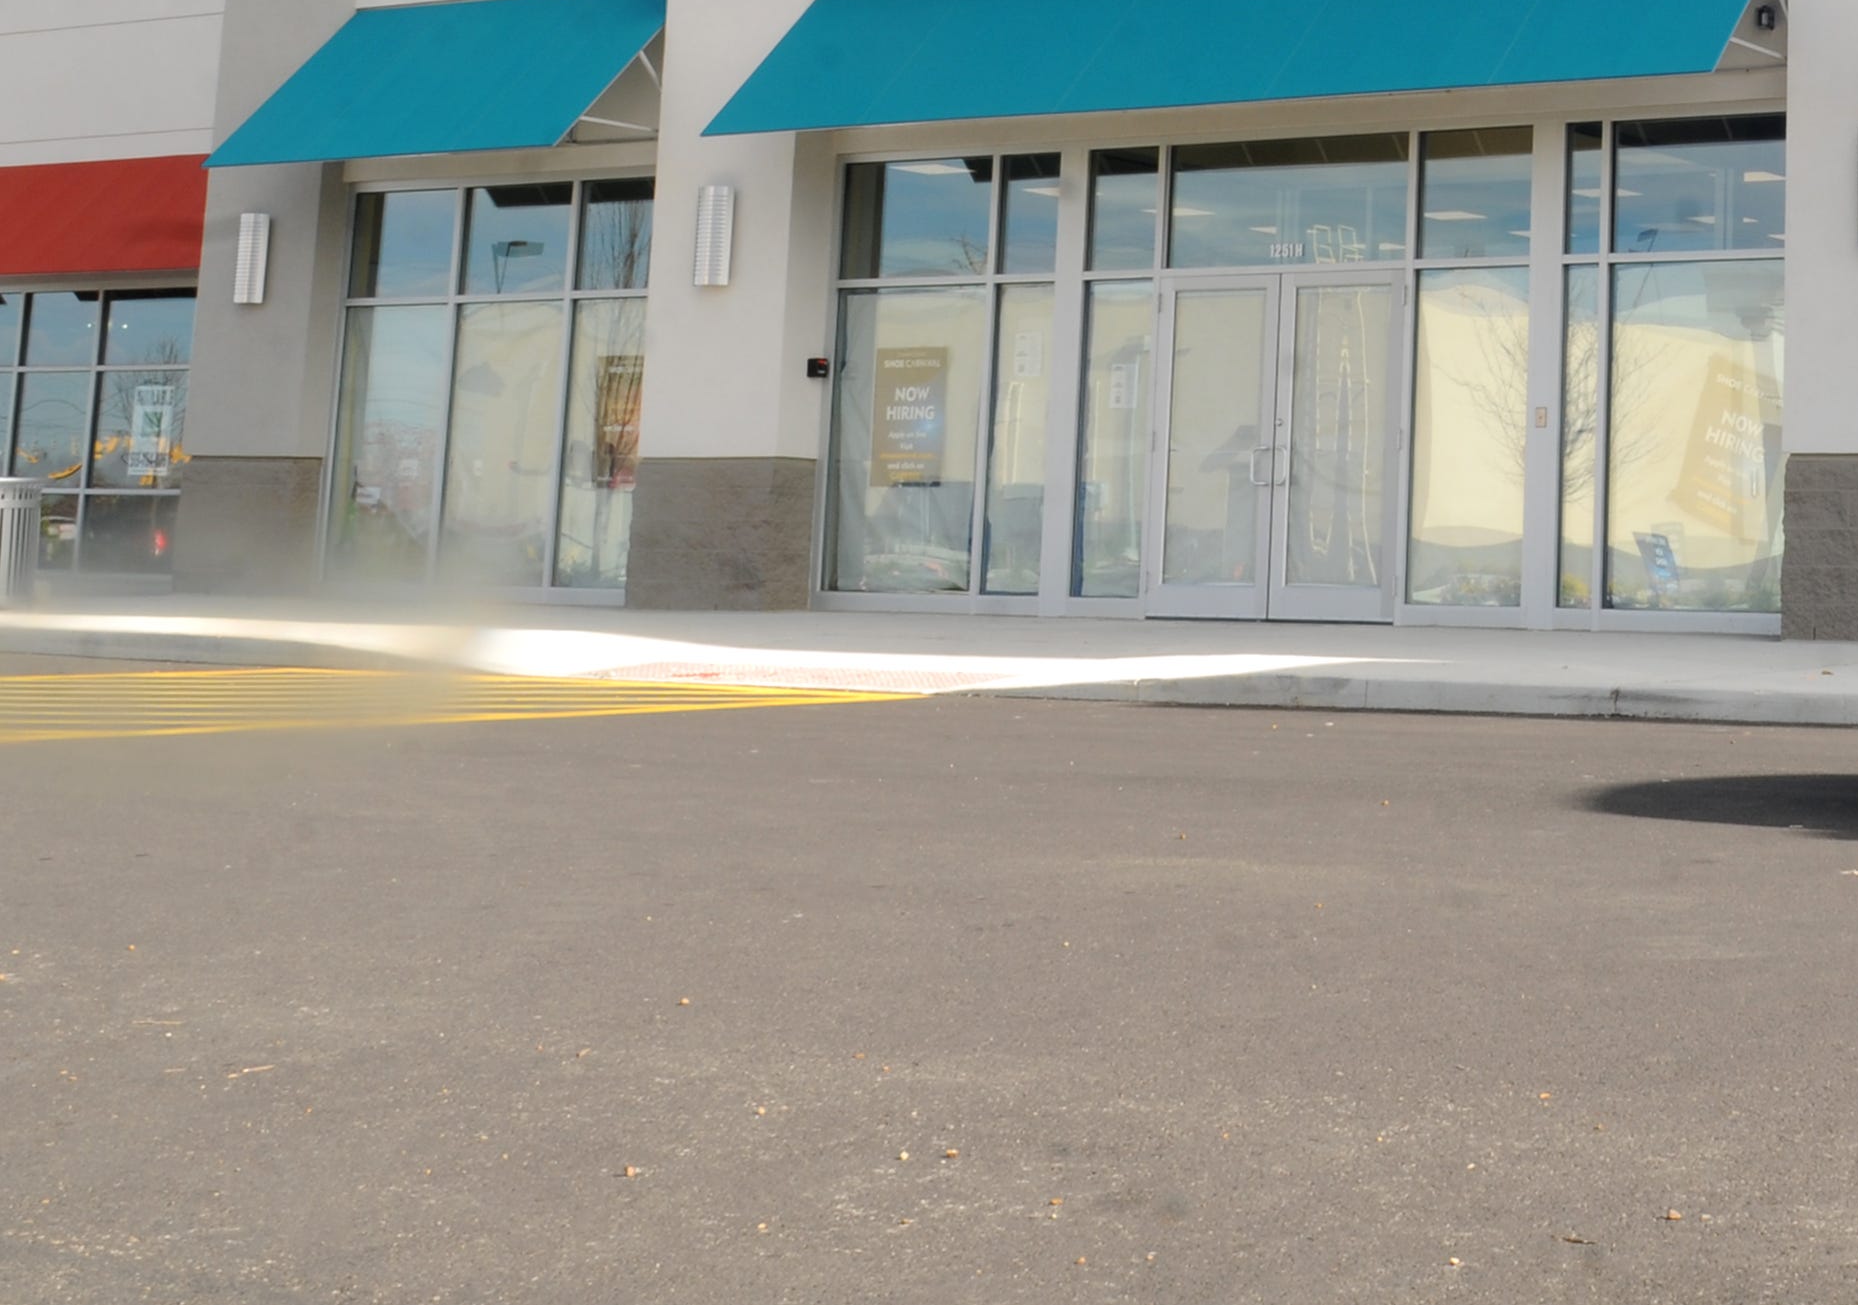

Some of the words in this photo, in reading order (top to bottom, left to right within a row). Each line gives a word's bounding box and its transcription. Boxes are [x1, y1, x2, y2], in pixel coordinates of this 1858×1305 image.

[895, 386, 931, 402] NOW
[885, 405, 936, 421] HIRING
[1721, 410, 1764, 438] NOW
[1705, 425, 1765, 464] HIRING
